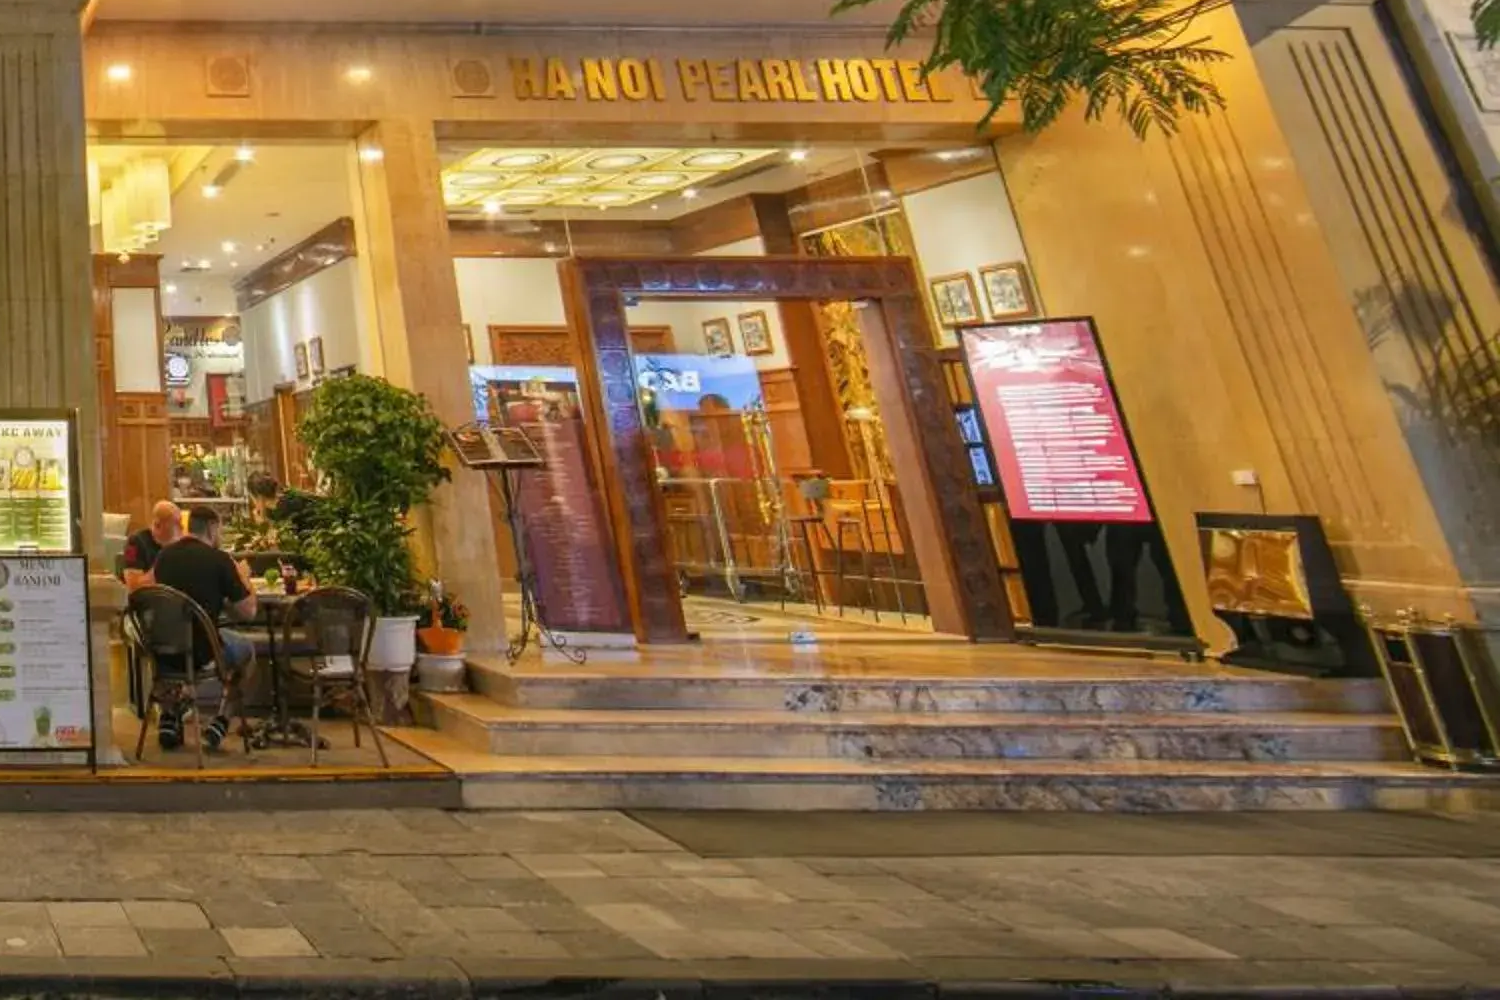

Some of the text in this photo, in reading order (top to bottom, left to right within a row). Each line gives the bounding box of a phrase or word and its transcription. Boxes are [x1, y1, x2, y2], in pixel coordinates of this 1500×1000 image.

[674, 58, 817, 102] PEARL
[813, 58, 953, 102] HOTEL
[23, 427, 61, 437] AWAY
